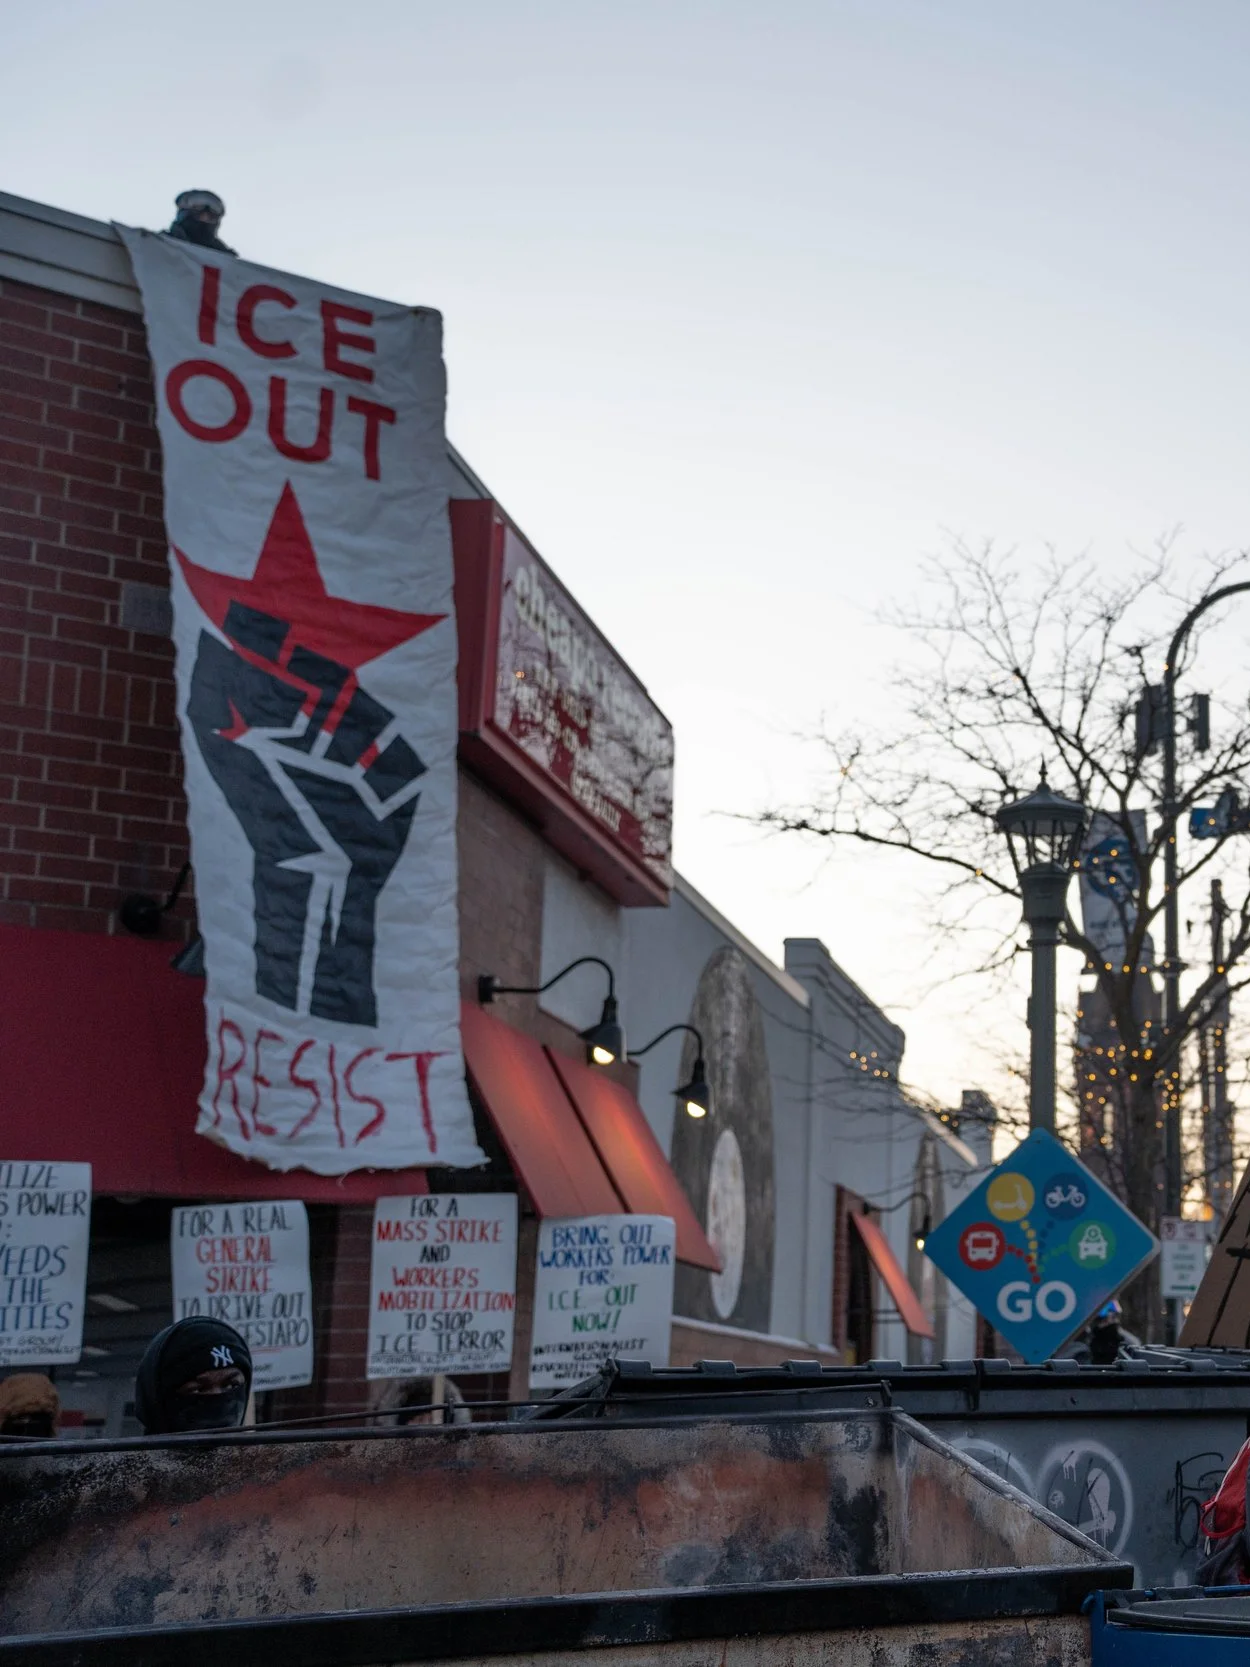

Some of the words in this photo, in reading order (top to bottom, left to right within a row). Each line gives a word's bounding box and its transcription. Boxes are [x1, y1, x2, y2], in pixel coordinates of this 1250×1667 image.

[197, 265, 377, 384] ICE
[166, 359, 397, 482] OUT
[213, 1006, 455, 1154] RESIST
[0, 1163, 59, 1189] LIZE
[17, 1191, 88, 1217] POWER
[410, 1198, 439, 1218] FOR
[446, 1198, 458, 1217] A
[179, 1209, 215, 1237] FOR
[222, 1208, 234, 1234] A
[243, 1205, 293, 1233] REAL
[376, 1219, 428, 1242] MASS
[434, 1220, 503, 1243] STRIKE
[552, 1225, 610, 1248] BRING
[619, 1224, 654, 1246] OUT
[195, 1235, 278, 1264] GENERAL
[419, 1244, 450, 1264] AND
[540, 1247, 614, 1269] WORKERS
[623, 1244, 671, 1266] POWER
[5, 1276, 52, 1304] THE
[206, 1265, 274, 1294] STRIKE
[391, 1266, 480, 1289] WORKERS
[208, 1294, 267, 1319] DRIVE
[272, 1292, 305, 1319] OUT
[377, 1290, 516, 1313] MOBILIZATION
[605, 1283, 639, 1307] OUT
[997, 1280, 1077, 1322] GO
[404, 1312, 426, 1331] TO
[430, 1311, 473, 1332] STOP
[572, 1308, 621, 1334] NOW!
[376, 1333, 421, 1354] ICE
[433, 1329, 505, 1354] TERROR
[210, 1345, 234, 1367] NY
